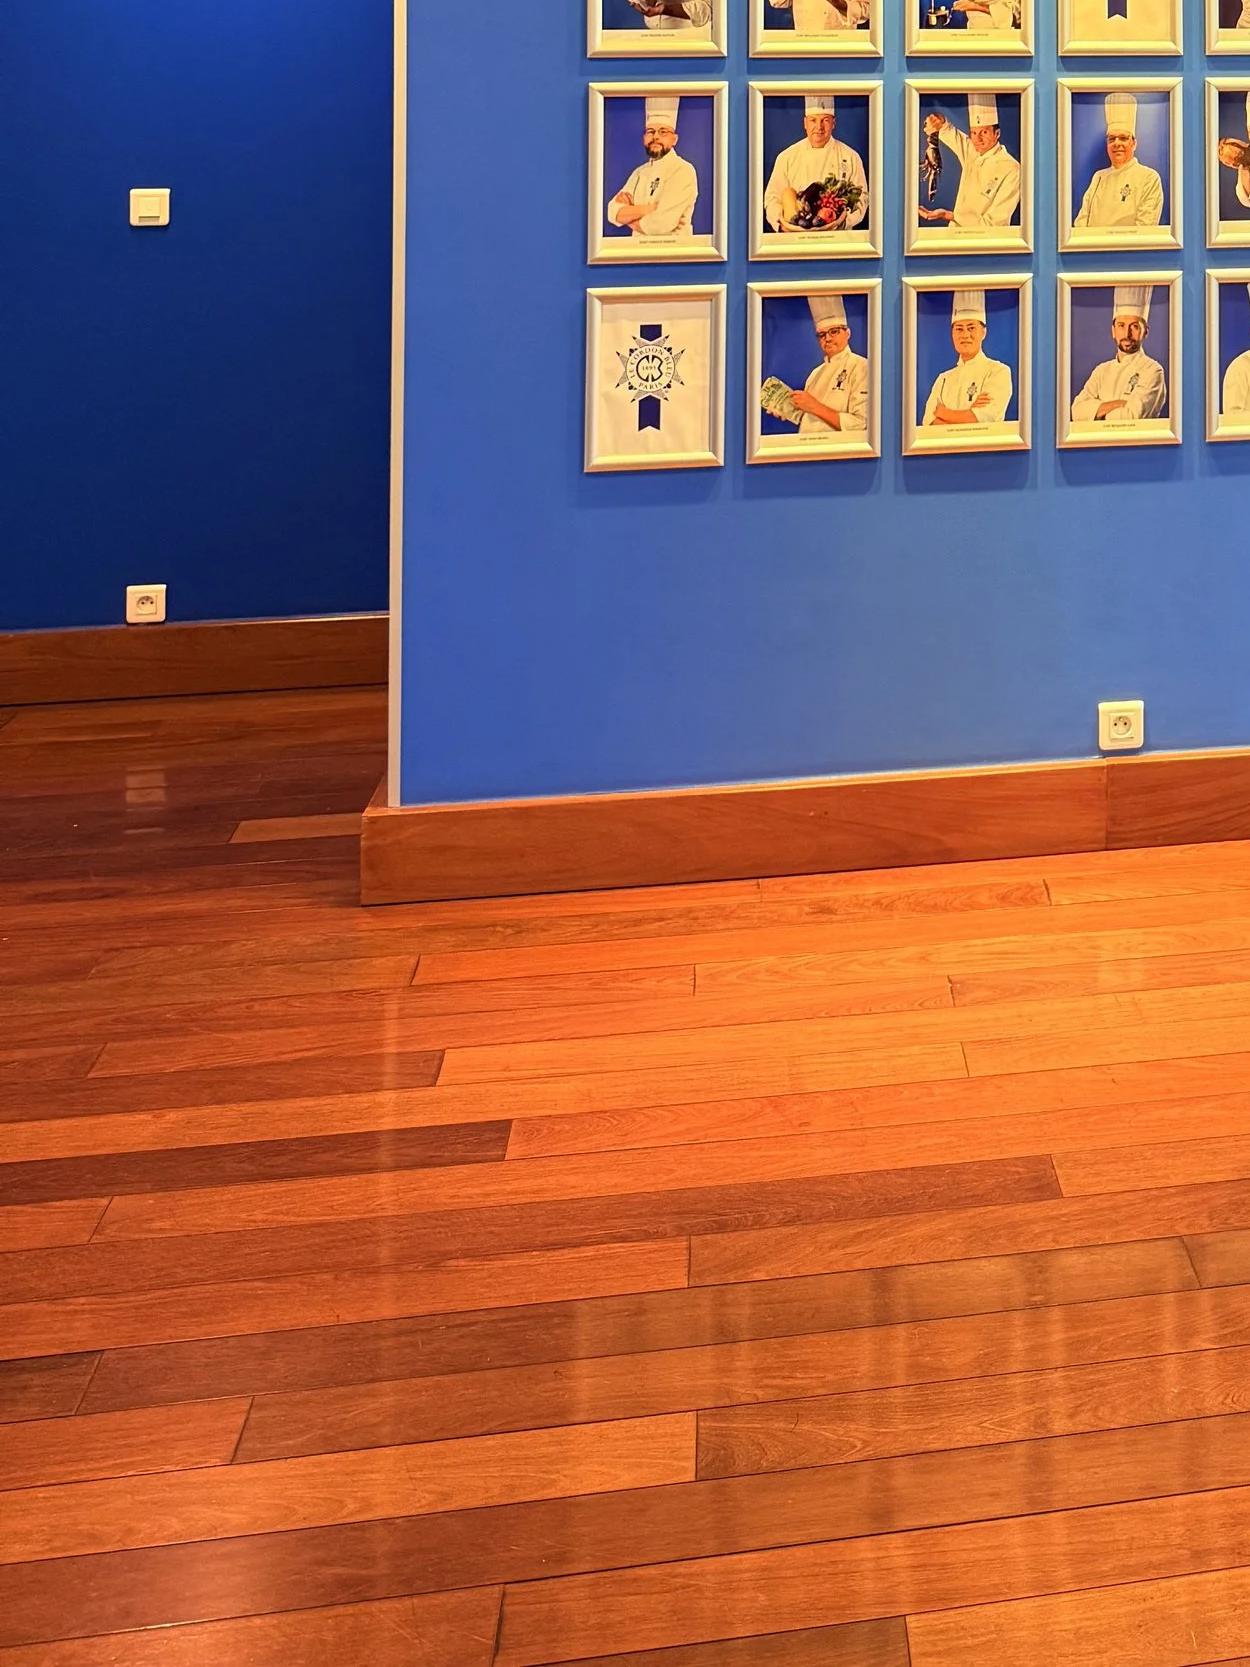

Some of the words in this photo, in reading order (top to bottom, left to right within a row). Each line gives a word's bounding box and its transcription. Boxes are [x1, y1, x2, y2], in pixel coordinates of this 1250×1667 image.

[630, 347, 665, 365] CORDON
[664, 356, 672, 378] BLEU
[638, 382, 663, 390] PARIS
